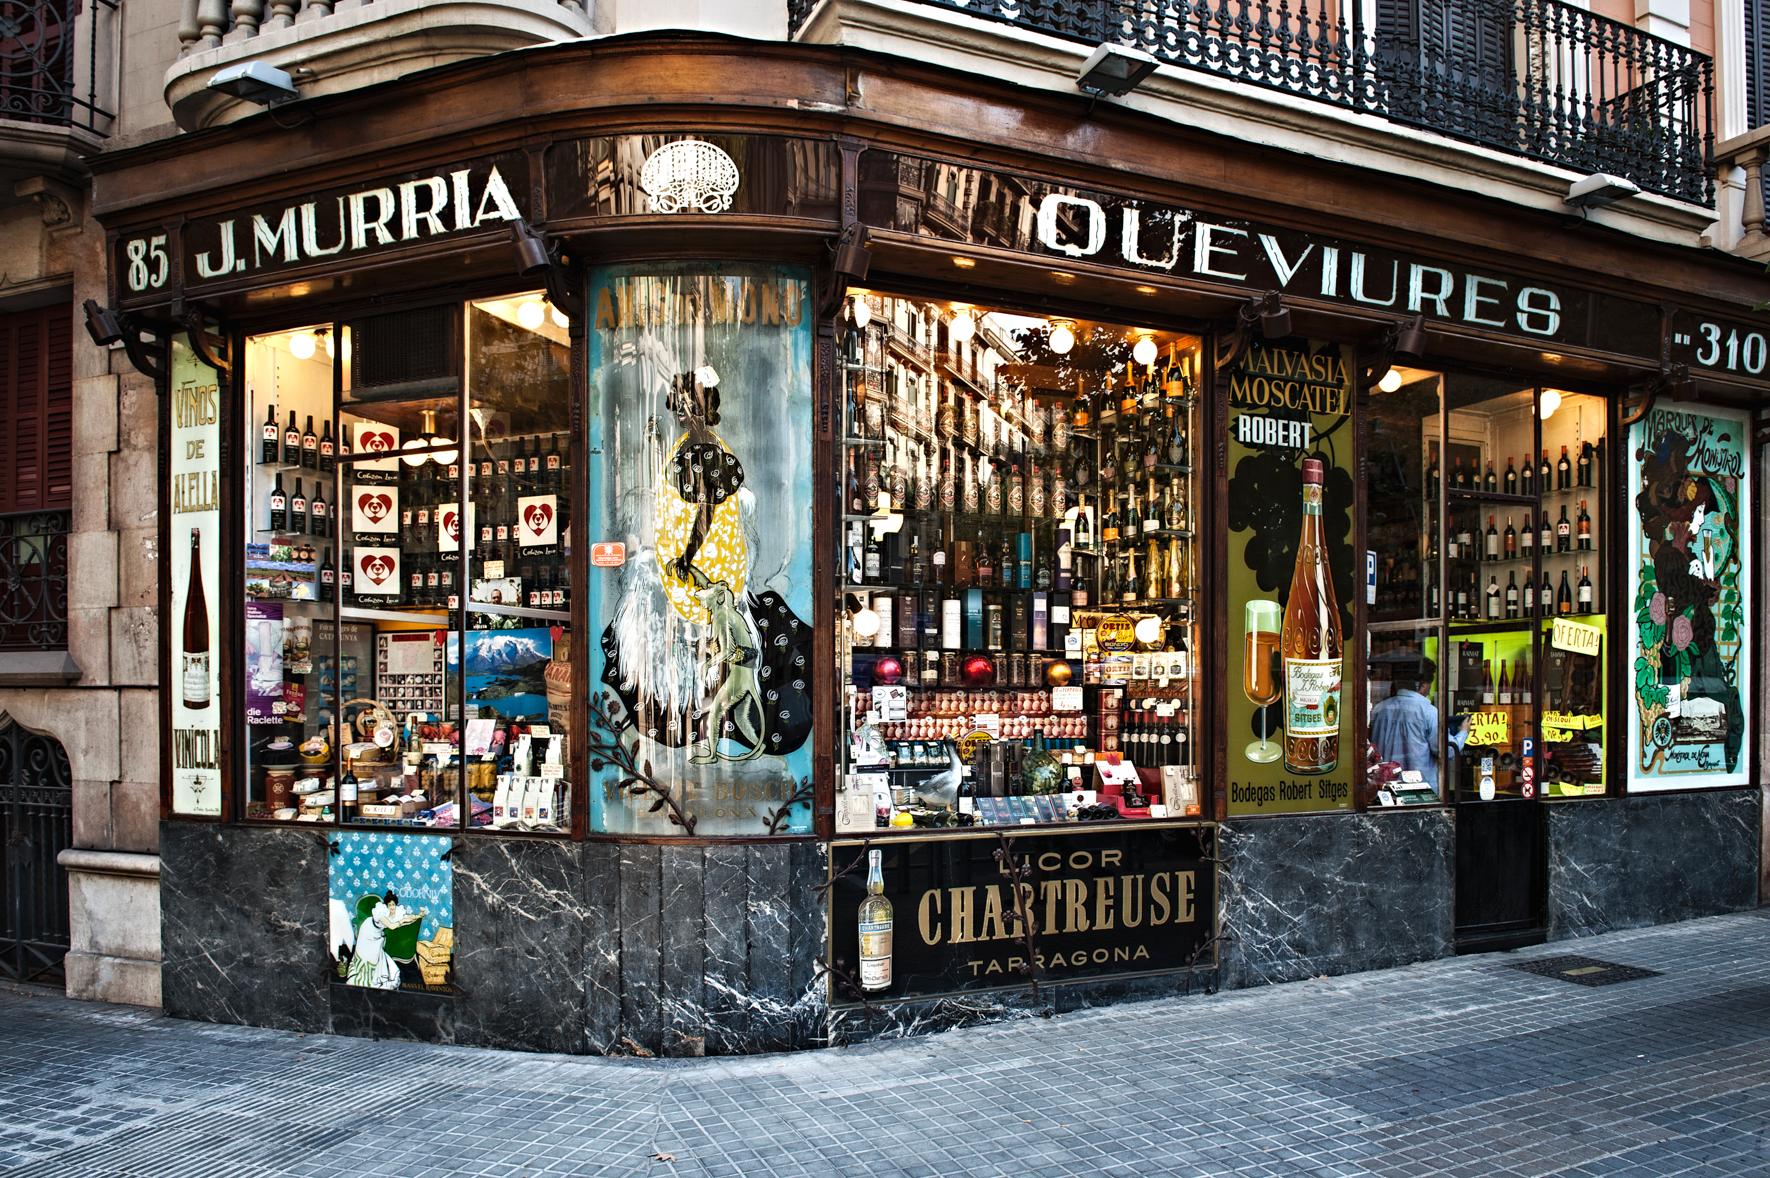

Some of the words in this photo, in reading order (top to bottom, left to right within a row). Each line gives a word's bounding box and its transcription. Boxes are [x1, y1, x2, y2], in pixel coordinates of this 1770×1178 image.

[126, 234, 169, 292] 85
[1036, 192, 1562, 337] QUEVIURES
[174, 380, 218, 429] VINOS
[1228, 373, 1352, 417] MOSCATEL
[1238, 413, 1313, 450] ROBERT
[186, 438, 206, 461] DE
[173, 470, 219, 516] ALELLA
[1553, 623, 1599, 649] OFERTA!
[247, 716, 284, 725] Raclette
[1294, 713, 1322, 723] SITGES
[1231, 781, 1276, 807] Bodegas
[1279, 780, 1313, 800] Robert
[1318, 779, 1348, 802] Sitges
[999, 849, 1123, 874] LICOR
[917, 869, 1196, 946] CHARTREUSE
[967, 943, 1151, 977] TARRAGONA
